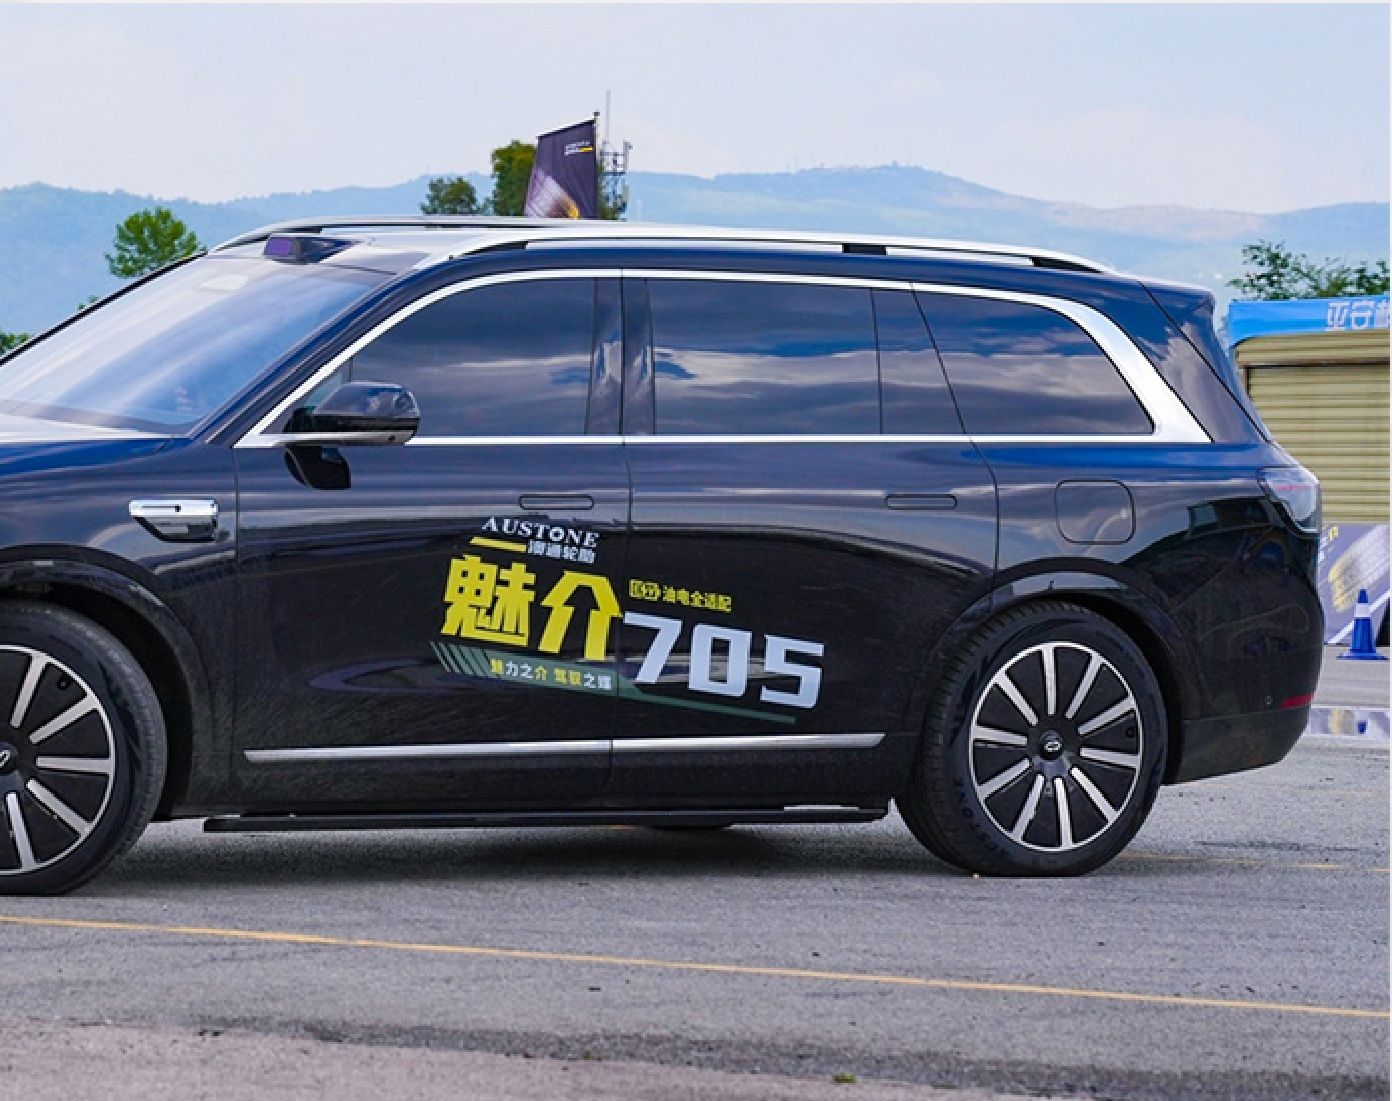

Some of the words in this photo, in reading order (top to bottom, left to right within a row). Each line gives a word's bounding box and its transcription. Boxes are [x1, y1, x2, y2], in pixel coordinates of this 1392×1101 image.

[481, 516, 599, 548] AUSTONE
[440, 553, 623, 662] 魅介
[621, 610, 826, 709] 705
